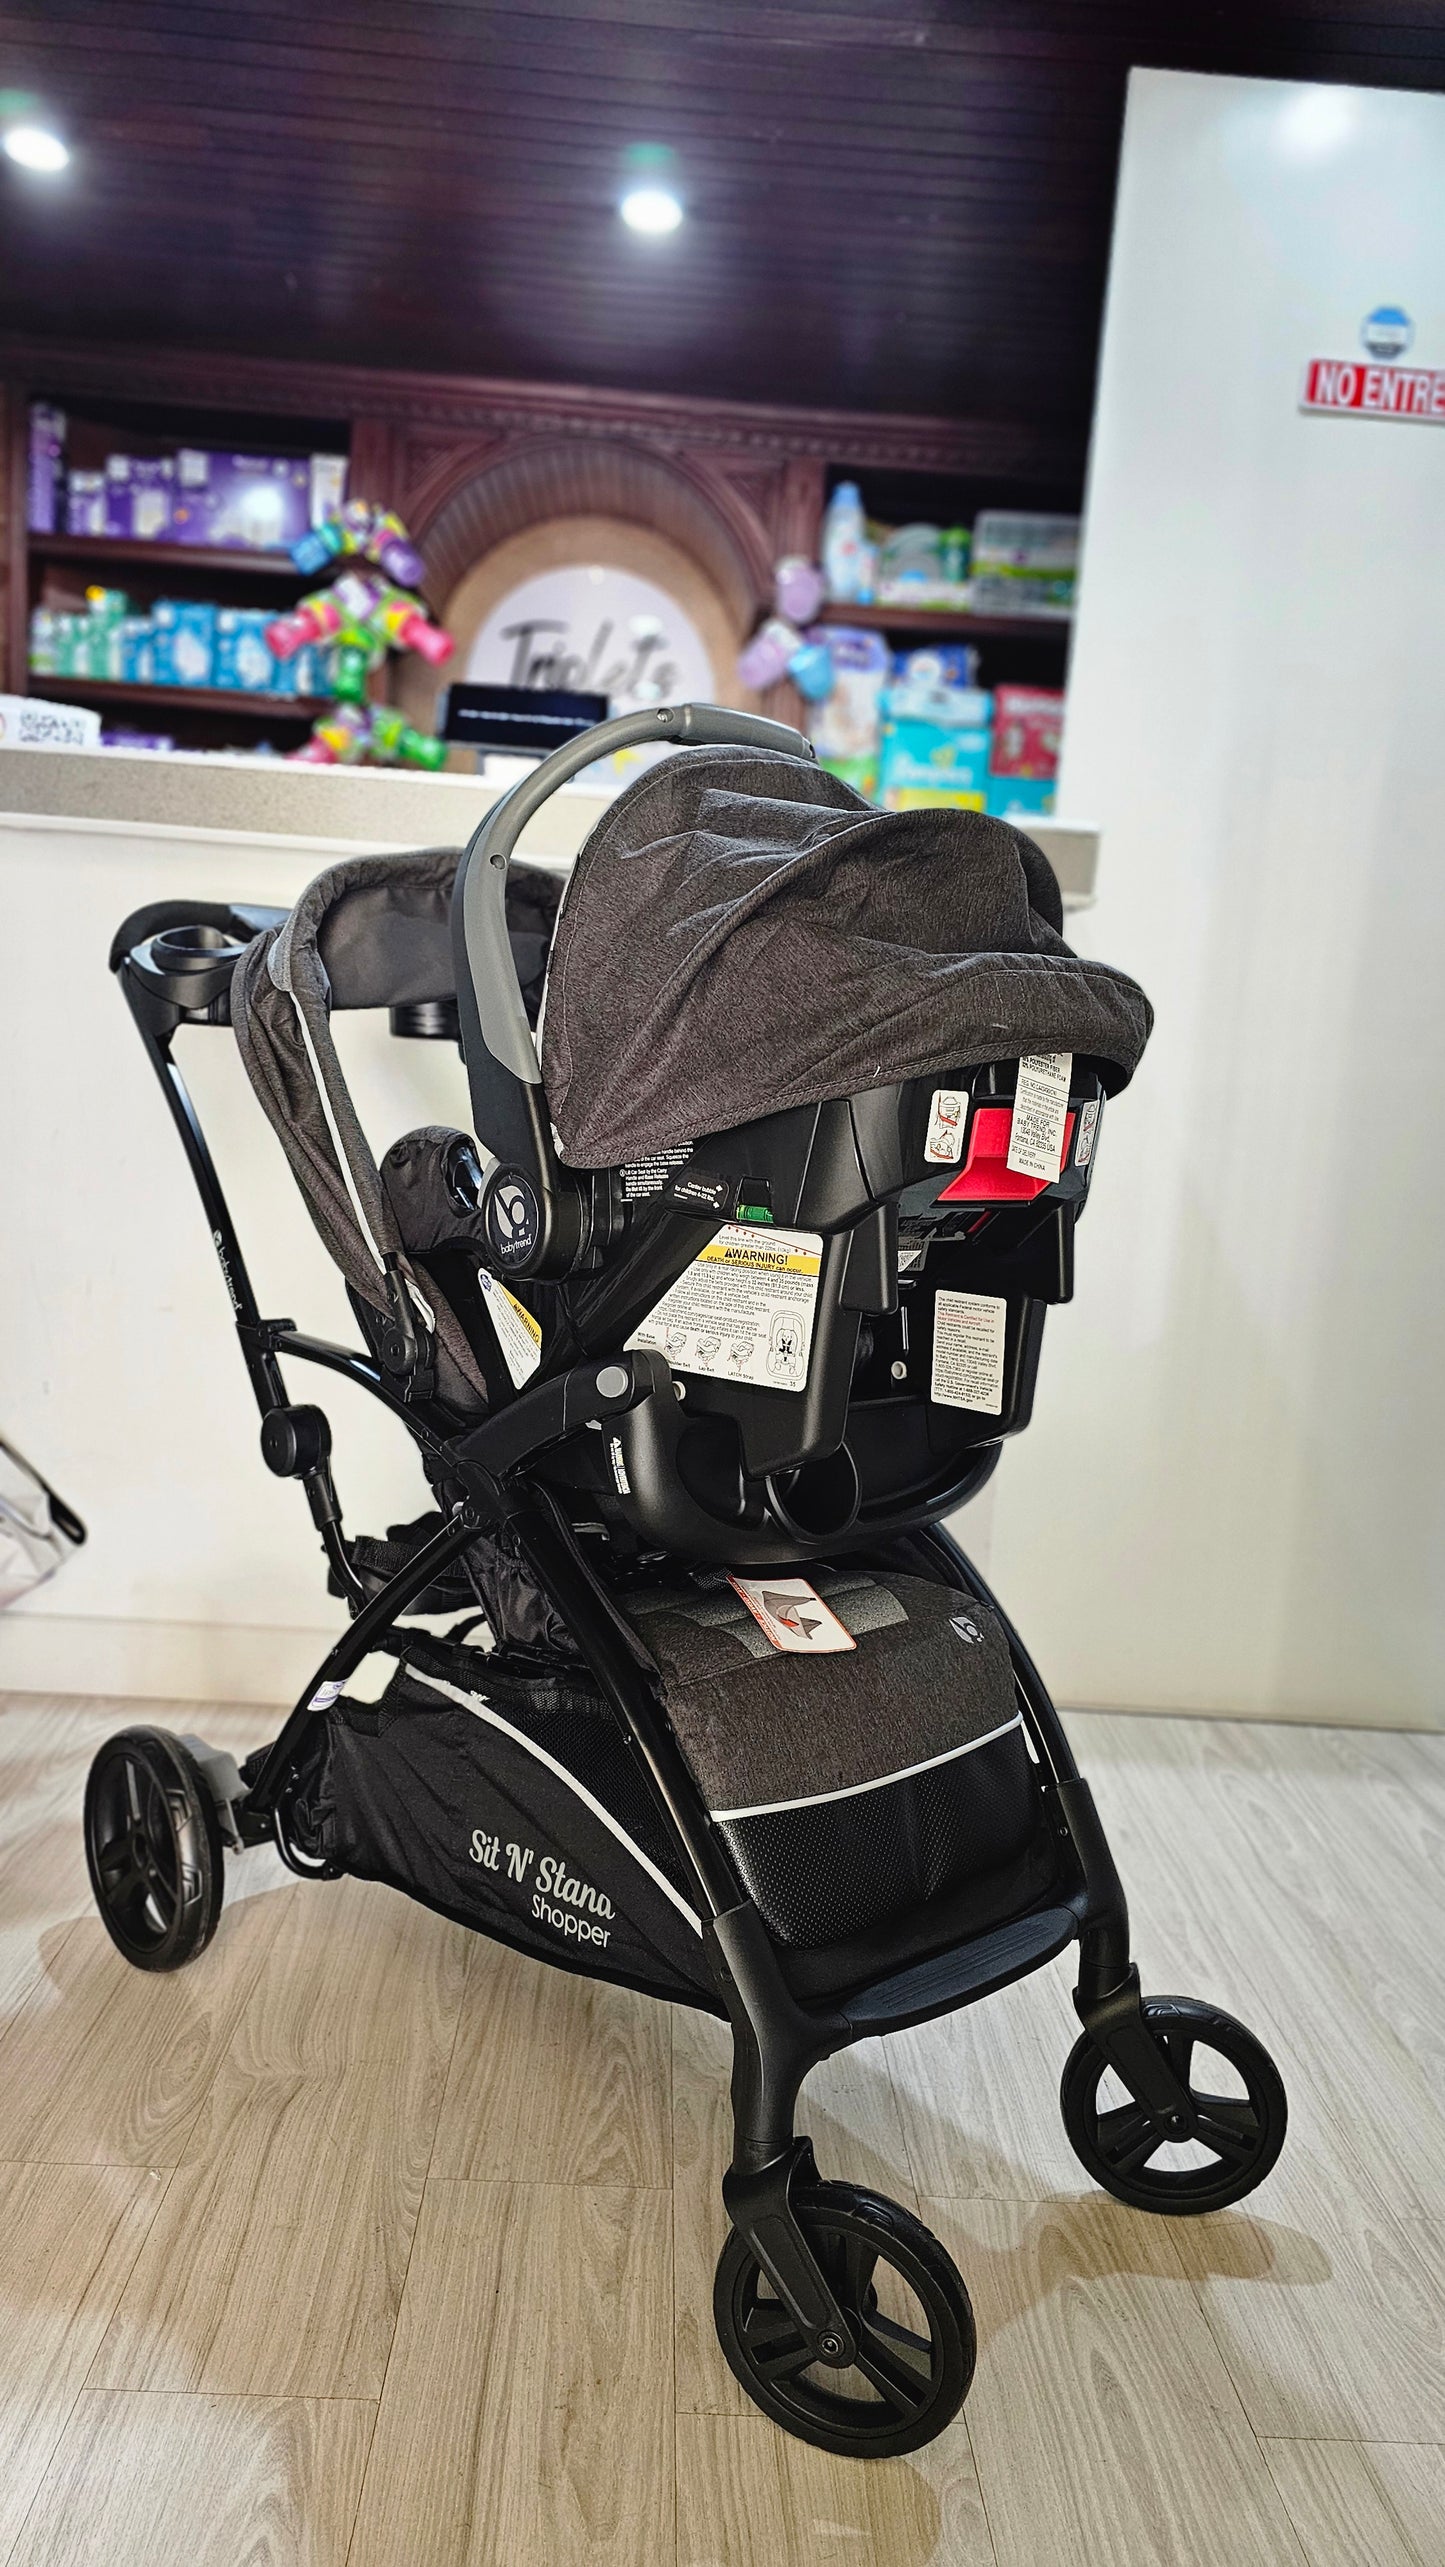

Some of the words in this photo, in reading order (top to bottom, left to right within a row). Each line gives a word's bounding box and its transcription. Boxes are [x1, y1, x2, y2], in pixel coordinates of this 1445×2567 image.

[1319, 364, 1356, 403] NO
[688, 1181, 701, 1190] Center
[702, 1185, 716, 1195] bubble
[731, 1249, 788, 1265] WARNING!
[469, 1830, 501, 1871] Sit
[506, 1843, 534, 1882] N'
[532, 1894, 611, 1947] Shopper
